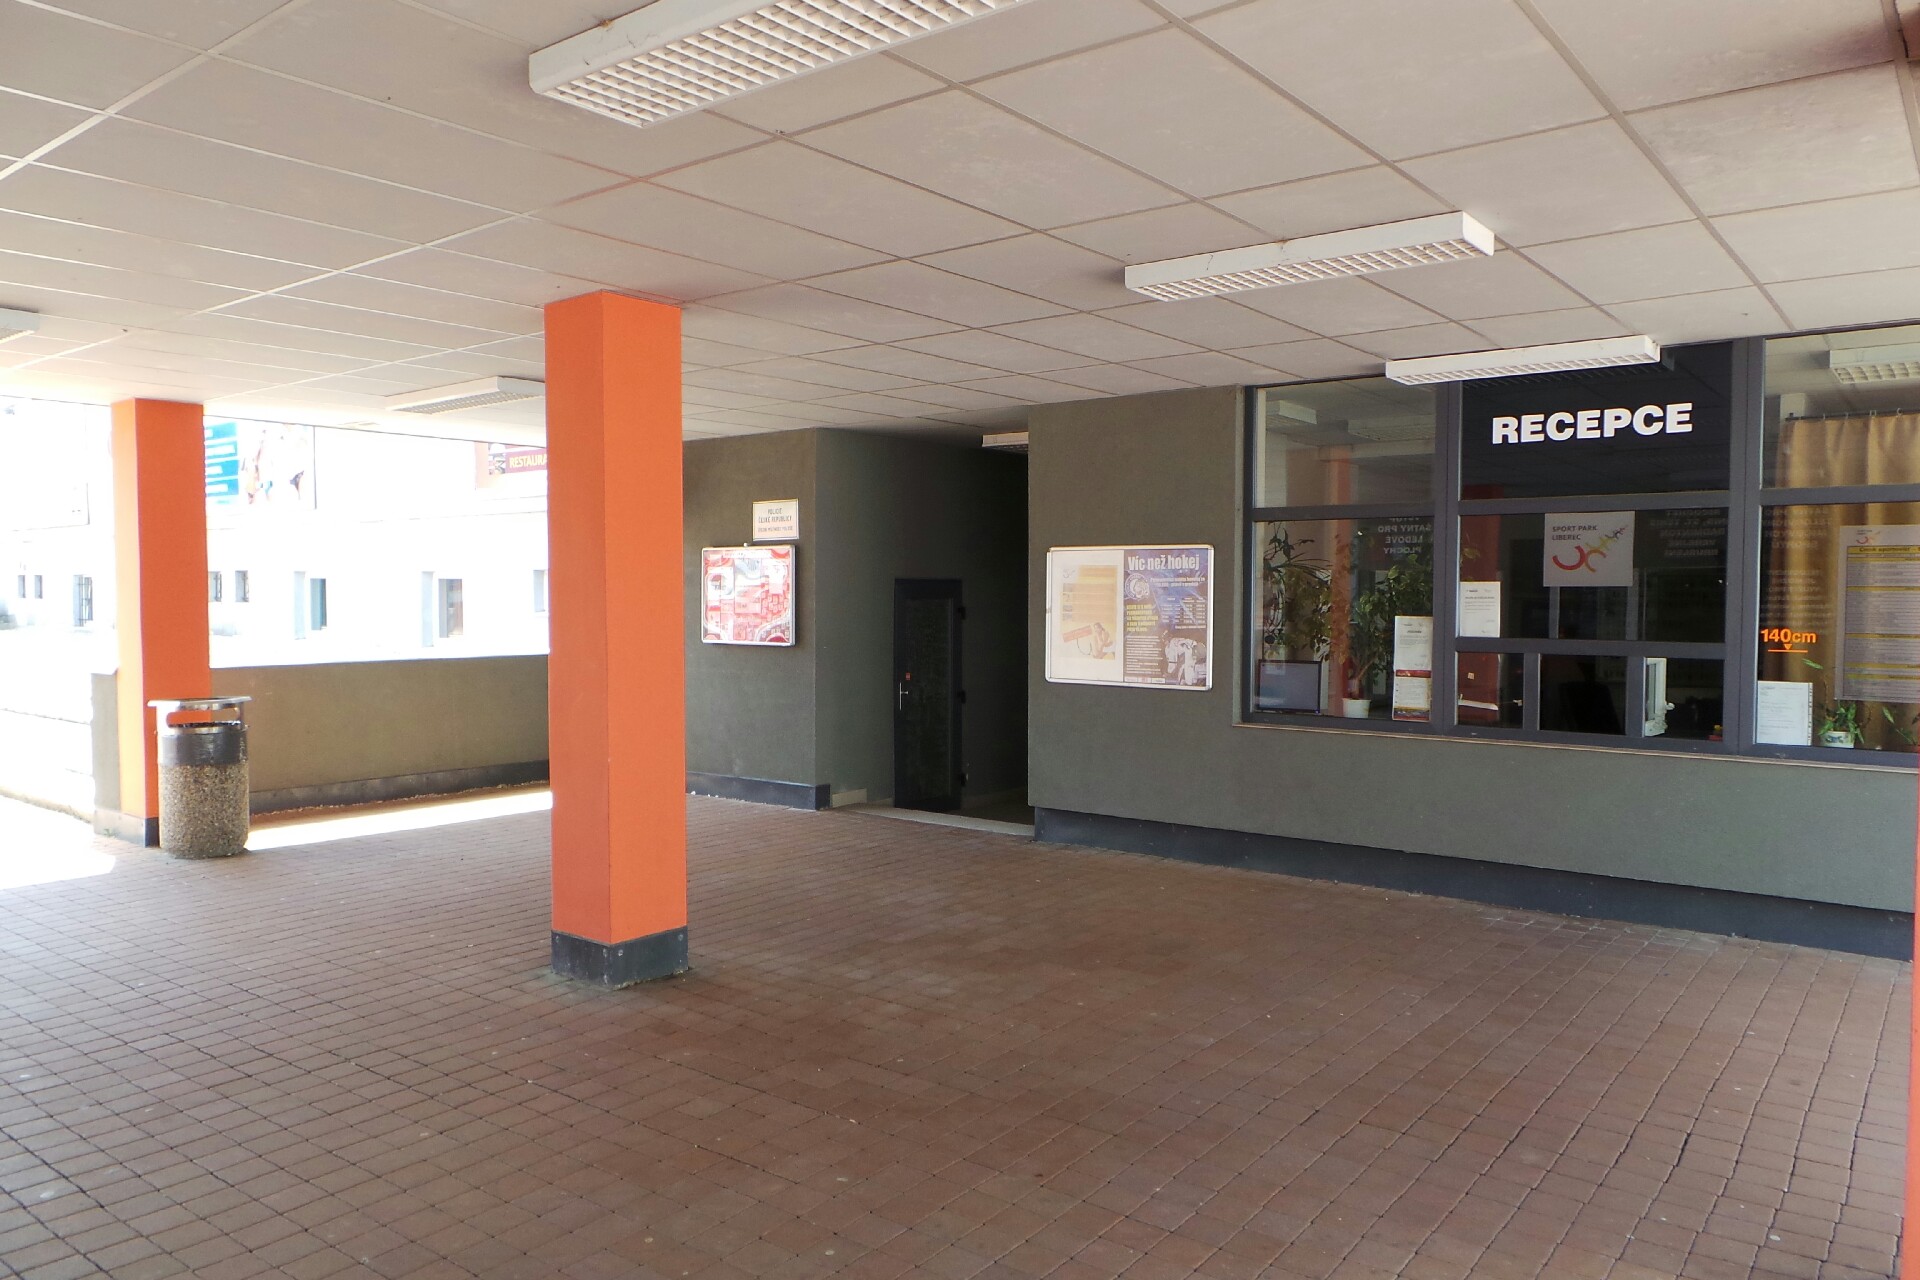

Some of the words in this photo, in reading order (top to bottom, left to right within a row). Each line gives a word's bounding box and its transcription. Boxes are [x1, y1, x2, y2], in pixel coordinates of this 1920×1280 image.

[1492, 402, 1693, 445] RECEPCE
[1552, 533, 1581, 541] LIBEREC
[1128, 556, 1145, 571] Víc
[1147, 554, 1166, 571] než
[1167, 554, 1199, 571] hokej
[1760, 628, 1817, 643] 140cm
